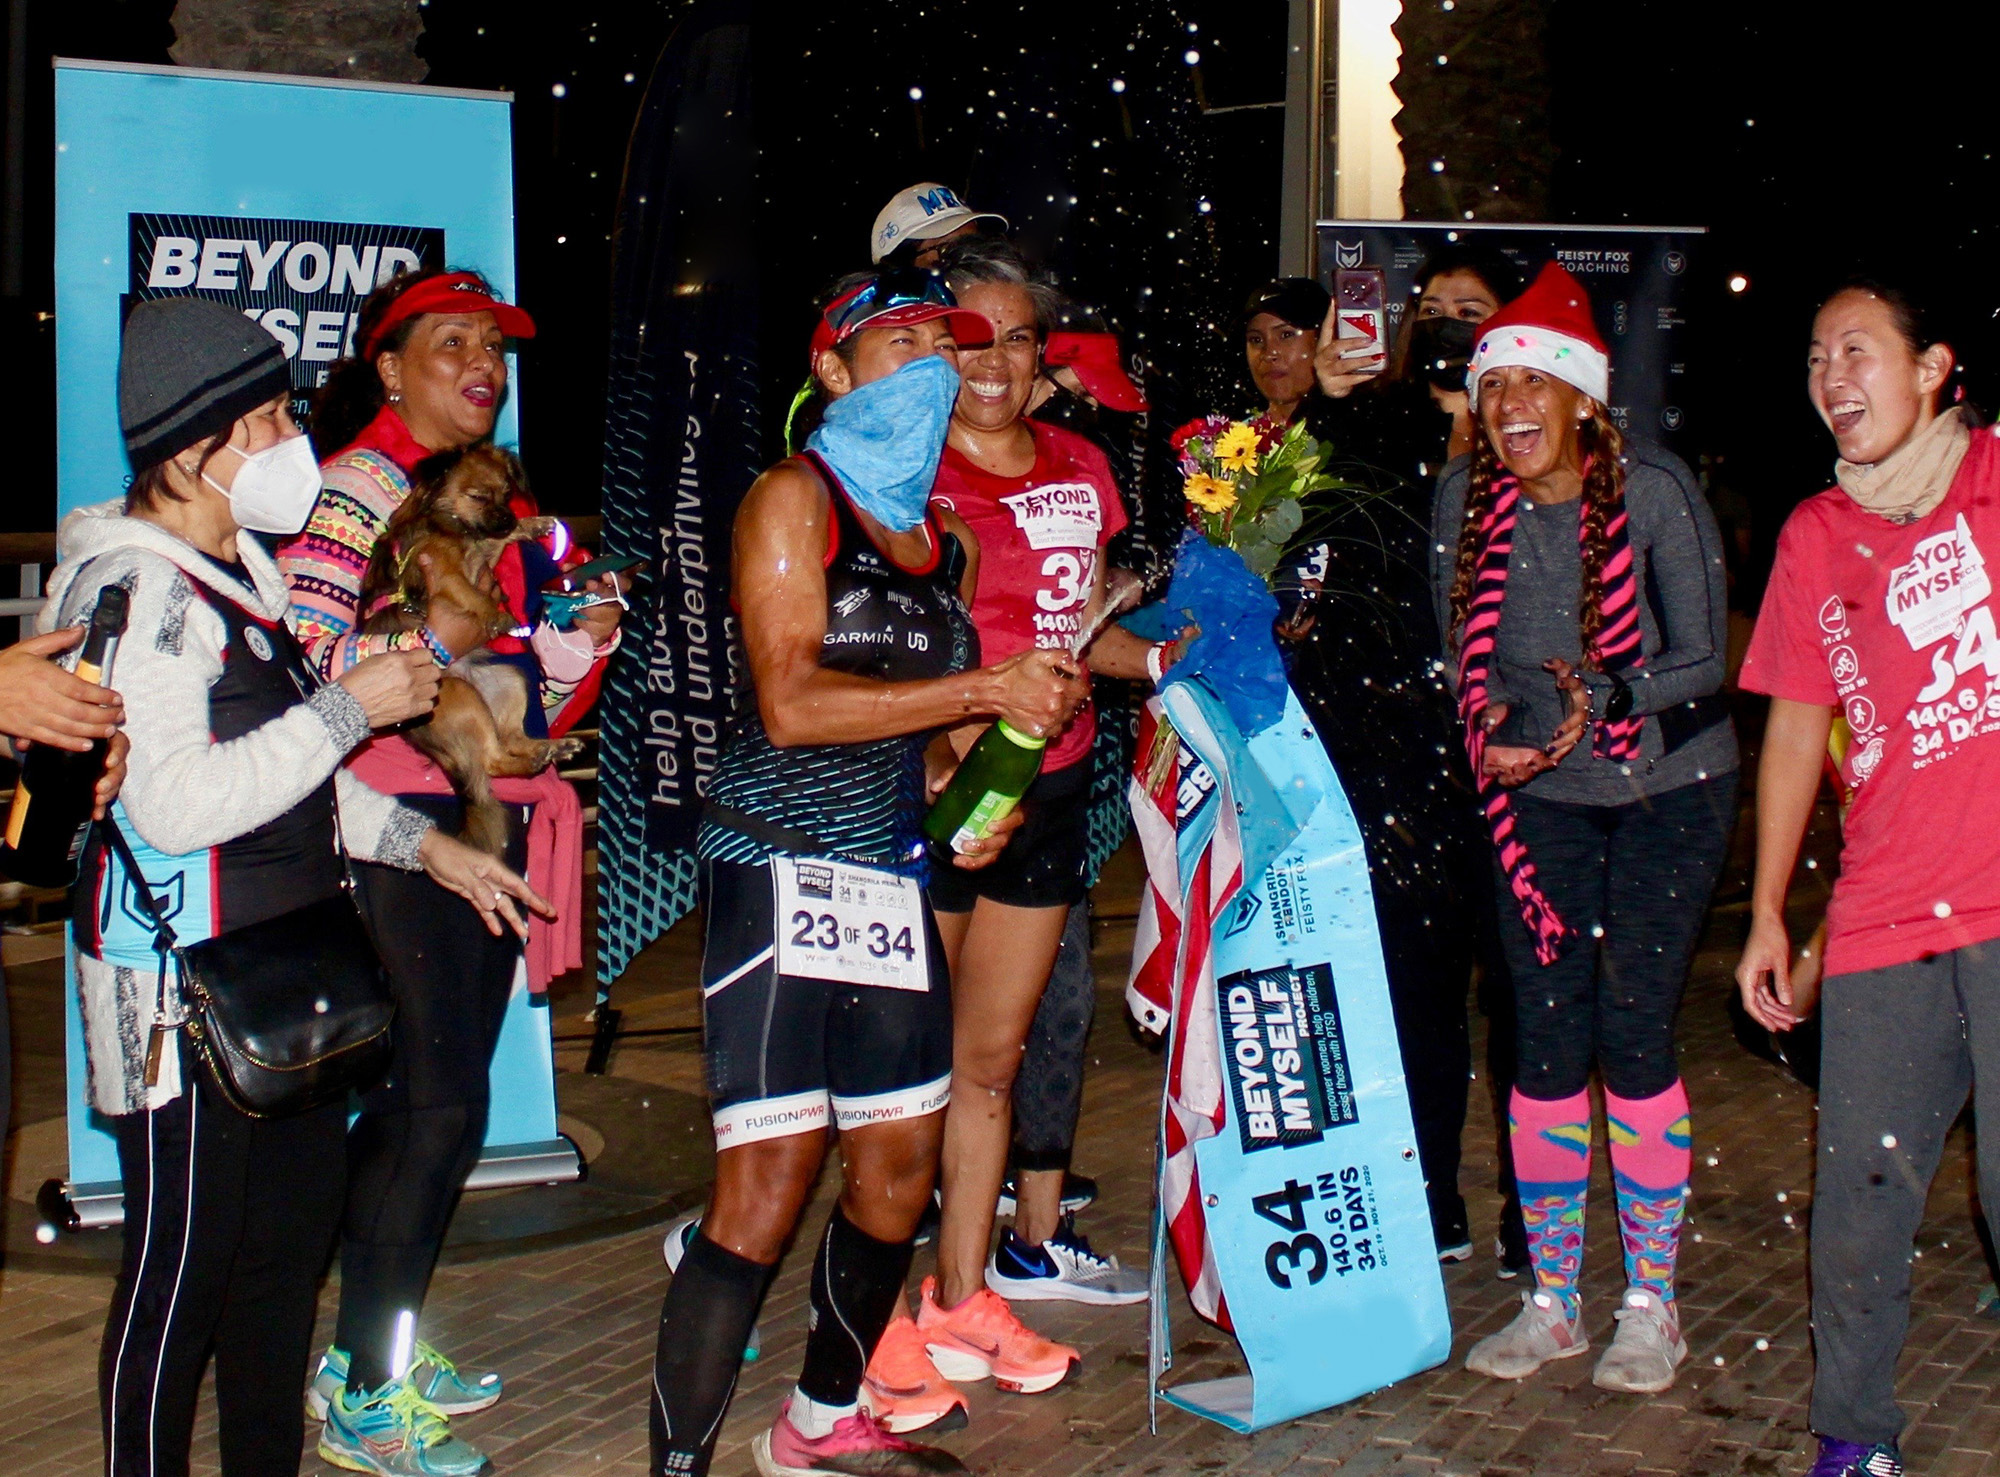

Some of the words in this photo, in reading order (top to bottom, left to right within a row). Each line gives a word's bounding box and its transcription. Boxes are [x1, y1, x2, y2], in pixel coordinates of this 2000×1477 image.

[148, 236, 420, 296] BEYOND
[1556, 250, 1601, 261] FEISTY
[1604, 251, 1631, 262] FOX
[823, 631, 894, 645] GARMIN
[1906, 688, 1979, 730] 140.6
[1912, 729, 1944, 756] 34
[644, 709, 682, 806] help
[798, 865, 832, 878] BEYOND
[798, 875, 832, 887] MYSELF
[1293, 855, 1309, 883] FOX
[838, 885, 851, 897] 34
[1298, 886, 1316, 934] FEISTY
[790, 909, 840, 951] 23
[843, 926, 861, 945] OF
[866, 922, 916, 962] 34
[1305, 970, 1321, 1013] children,
[1288, 973, 1310, 1038] PROJECT
[1310, 1015, 1324, 1036] help
[1324, 1012, 1338, 1038] PTSD
[1227, 985, 1279, 1139] BEYOND
[1258, 980, 1313, 1131] MYSELF
[1317, 1037, 1332, 1076] women,
[1328, 1040, 1343, 1062] with
[1332, 1065, 1347, 1092] those
[835, 1106, 904, 1123] FUSIONPWR
[1323, 1080, 1340, 1122] empower
[1337, 1093, 1353, 1120] assist
[745, 1104, 825, 1130] FUSIONPWR
[1316, 1172, 1338, 1200] IN
[1362, 1164, 1373, 1187] 2020
[1339, 1166, 1369, 1233] DAYS
[1370, 1205, 1380, 1225] NOV.
[1251, 1178, 1329, 1290] 34
[1324, 1207, 1354, 1277] 140.6
[1375, 1233, 1383, 1244] 19
[1354, 1238, 1376, 1272] 34
[1378, 1246, 1388, 1267] OCT.
